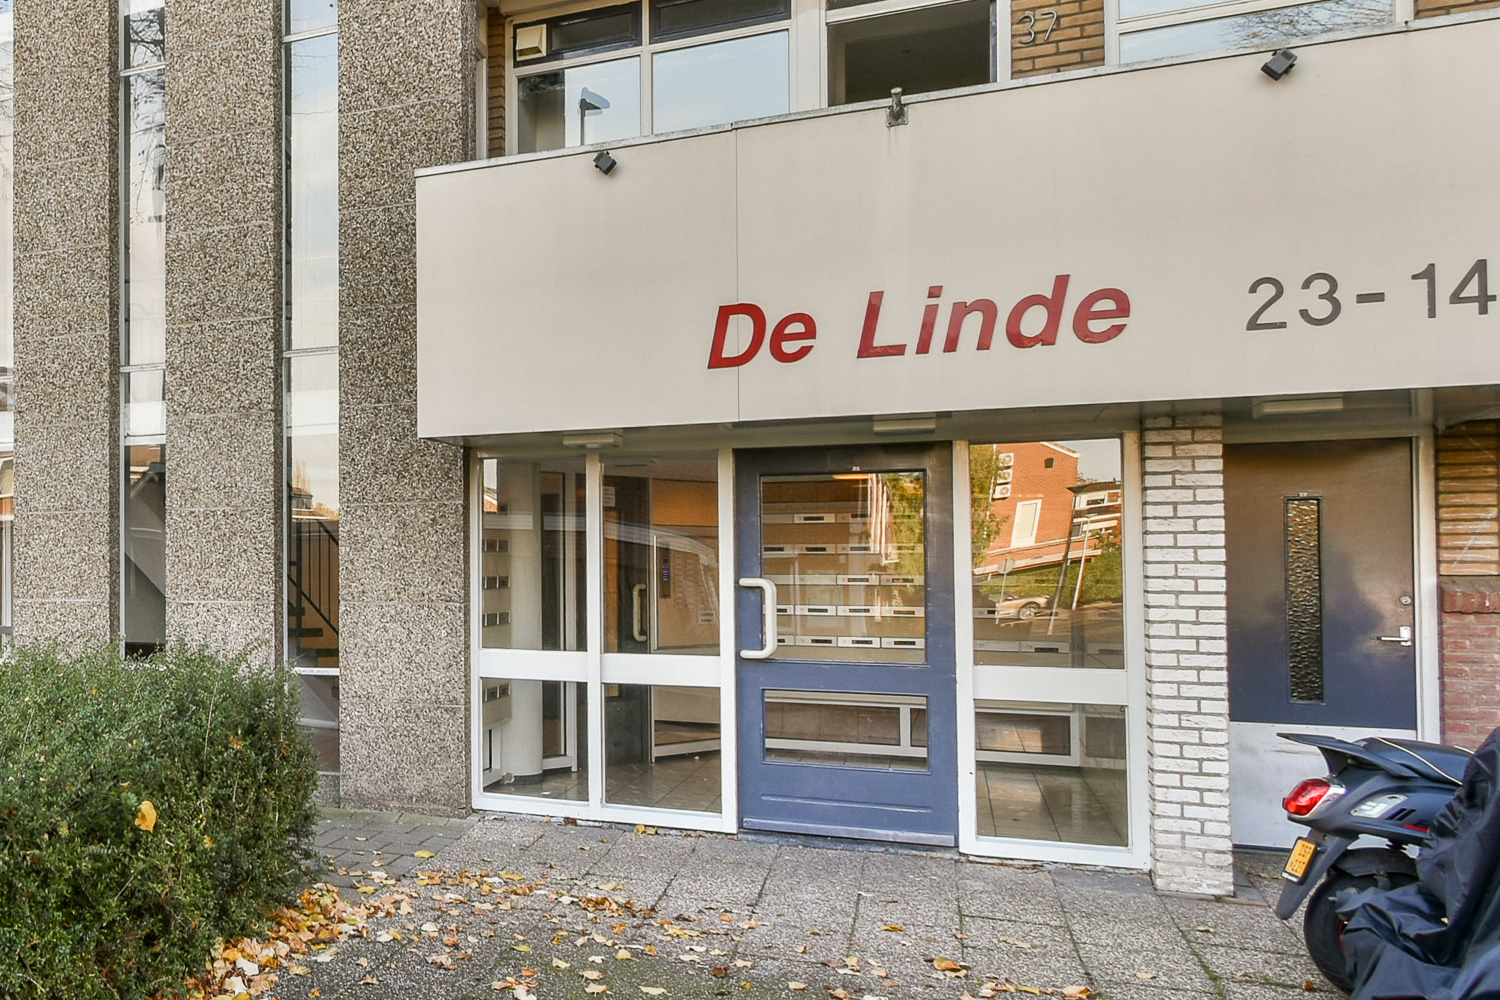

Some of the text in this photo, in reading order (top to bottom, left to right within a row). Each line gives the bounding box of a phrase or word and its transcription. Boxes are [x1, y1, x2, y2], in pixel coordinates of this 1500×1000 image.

[1018, 10, 1057, 44] 37
[707, 303, 817, 369] De
[857, 274, 1131, 358] Linde
